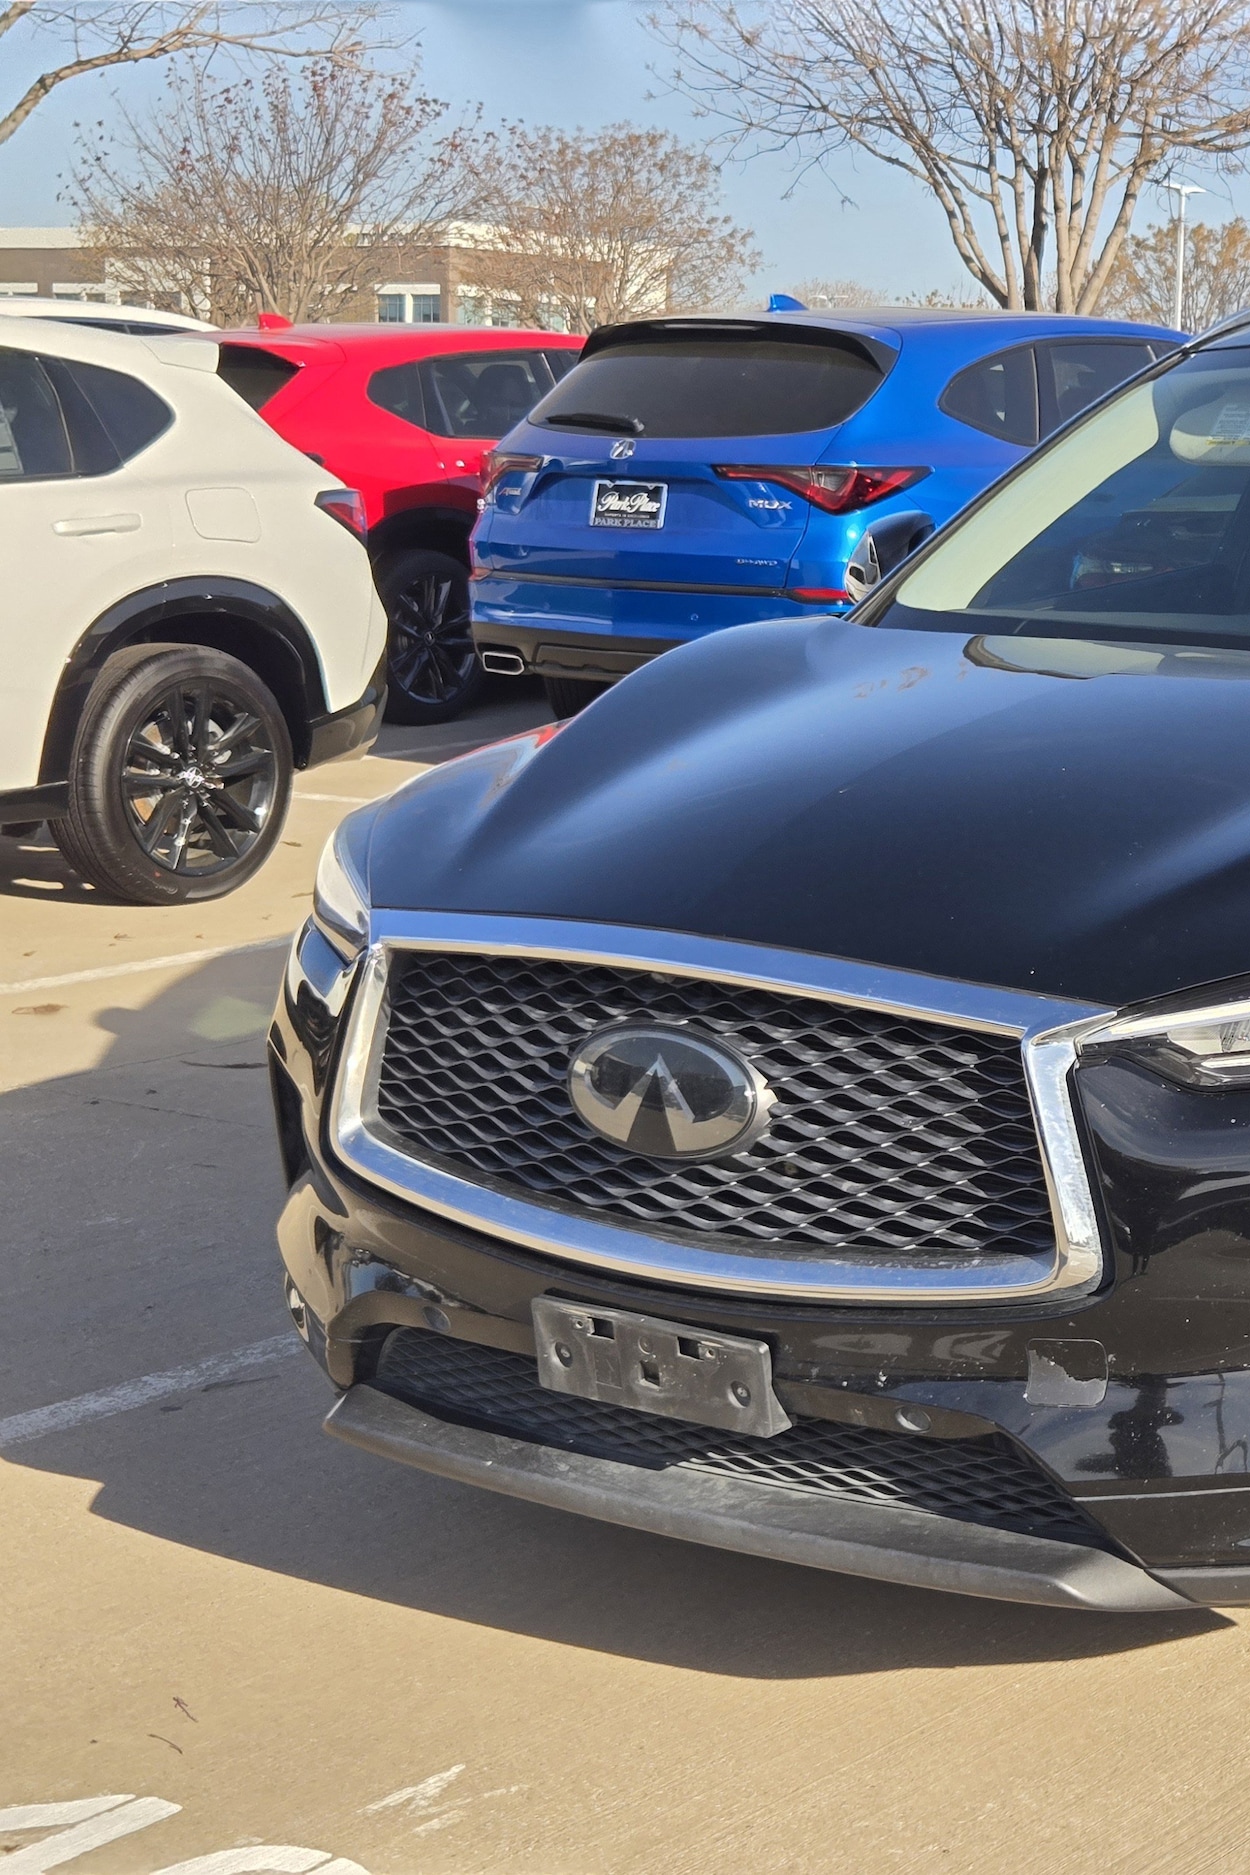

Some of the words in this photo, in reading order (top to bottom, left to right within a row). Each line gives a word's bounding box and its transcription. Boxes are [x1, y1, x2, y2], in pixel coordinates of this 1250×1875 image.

[597, 491, 631, 512] Park
[627, 492, 661, 513] Place
[748, 499, 793, 510] MDX
[594, 517, 621, 527] PARK
[624, 519, 657, 528] PLACE
